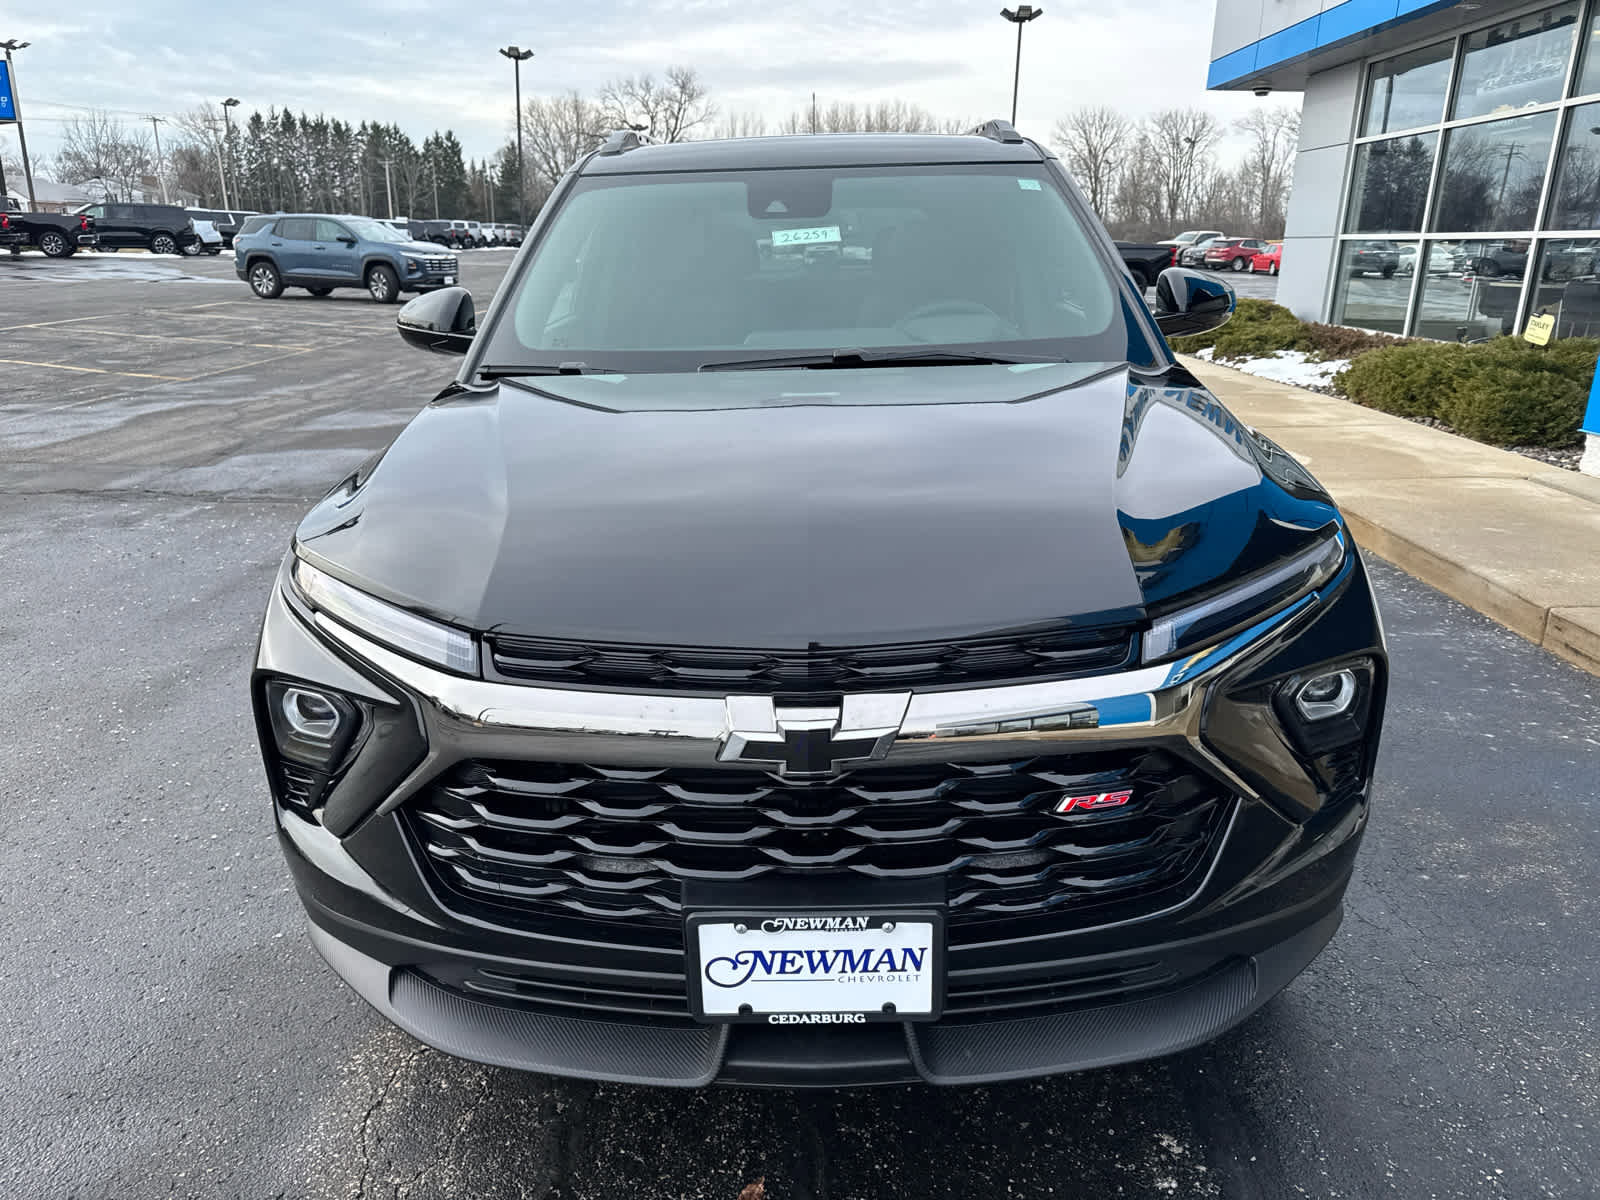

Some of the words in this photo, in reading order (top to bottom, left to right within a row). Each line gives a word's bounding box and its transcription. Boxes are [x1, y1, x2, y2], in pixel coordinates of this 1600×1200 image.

[1056, 789, 1133, 812] RS
[761, 917, 869, 934] NEWMAN
[704, 947, 928, 988] NEWMAN
[838, 975, 921, 984] CHEVROLET
[768, 1013, 866, 1024] CEDARBURG
